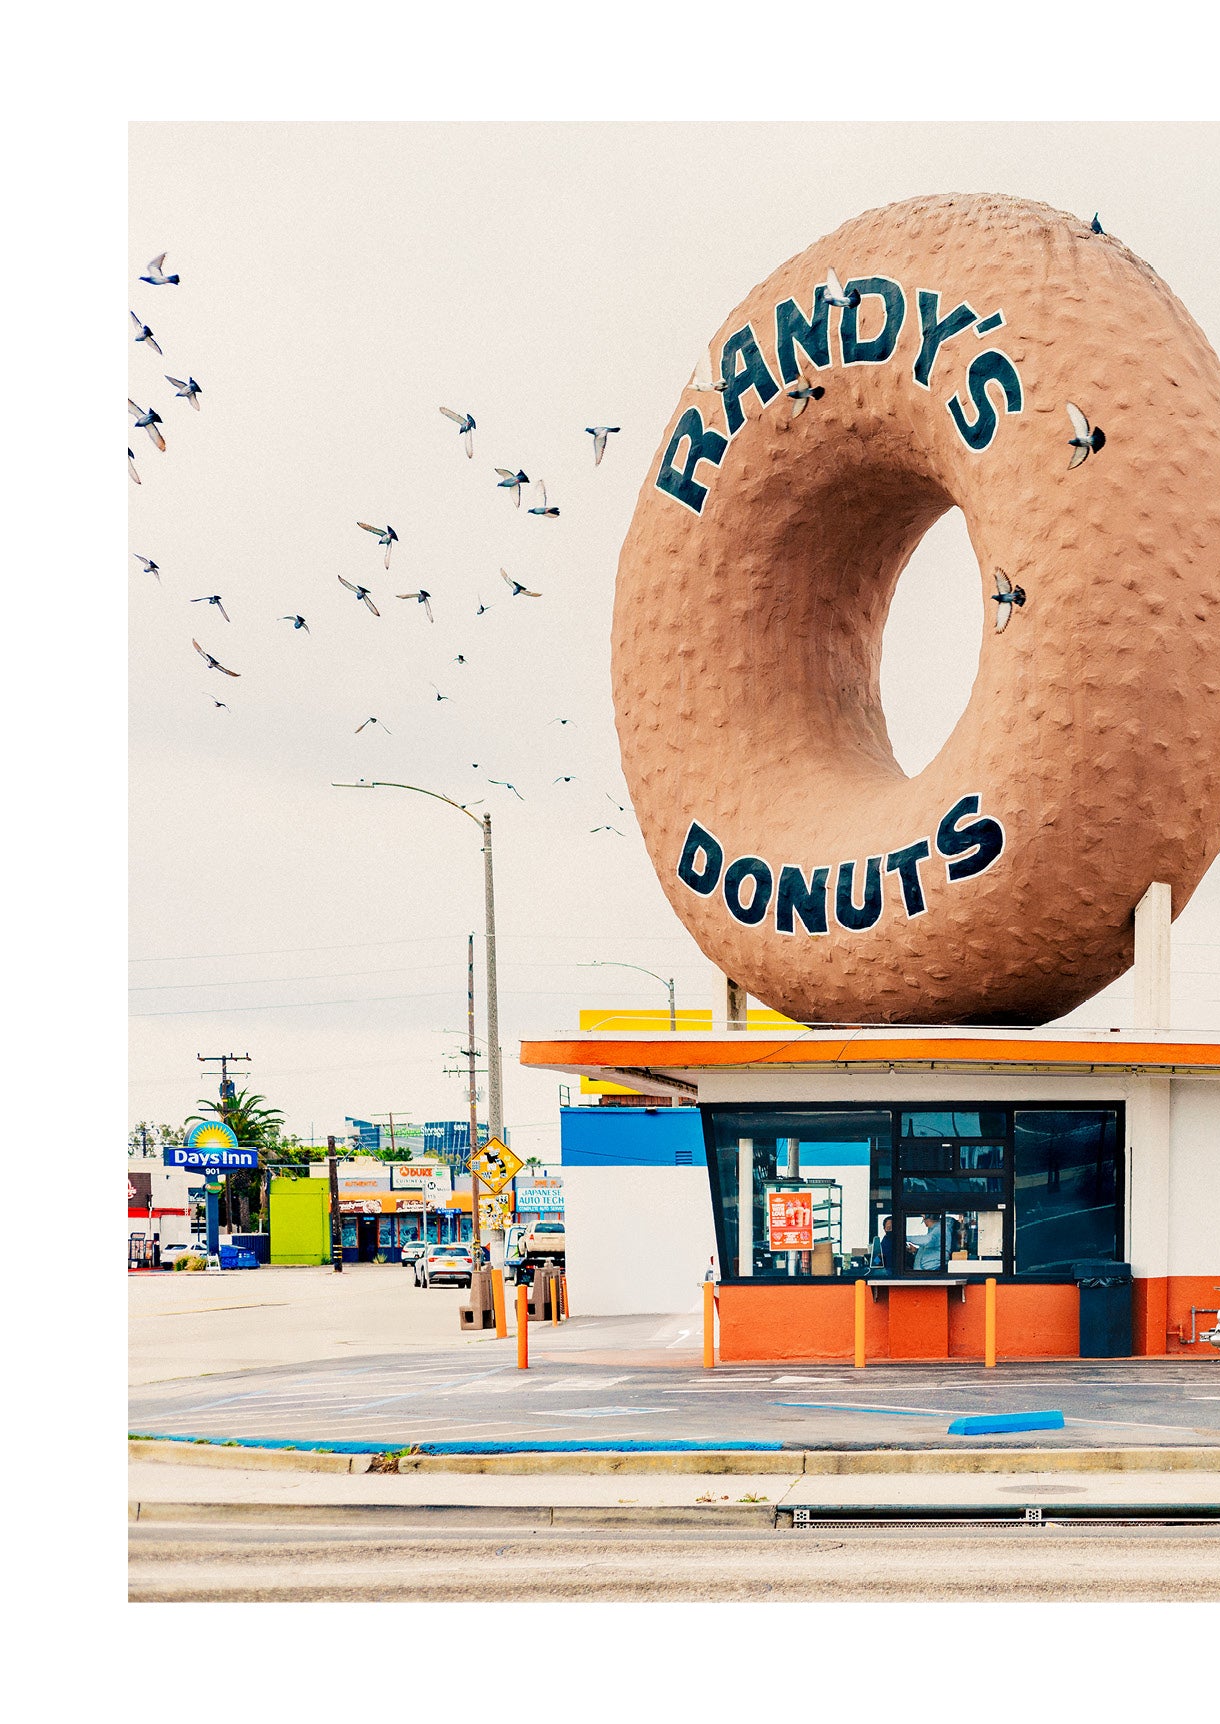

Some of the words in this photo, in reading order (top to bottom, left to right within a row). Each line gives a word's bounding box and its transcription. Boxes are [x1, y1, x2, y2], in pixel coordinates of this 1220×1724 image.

[655, 276, 1023, 516] RANDY'S
[677, 792, 1005, 934] DONUTS
[174, 1149, 219, 1166] Days
[222, 1151, 252, 1165] Inn
